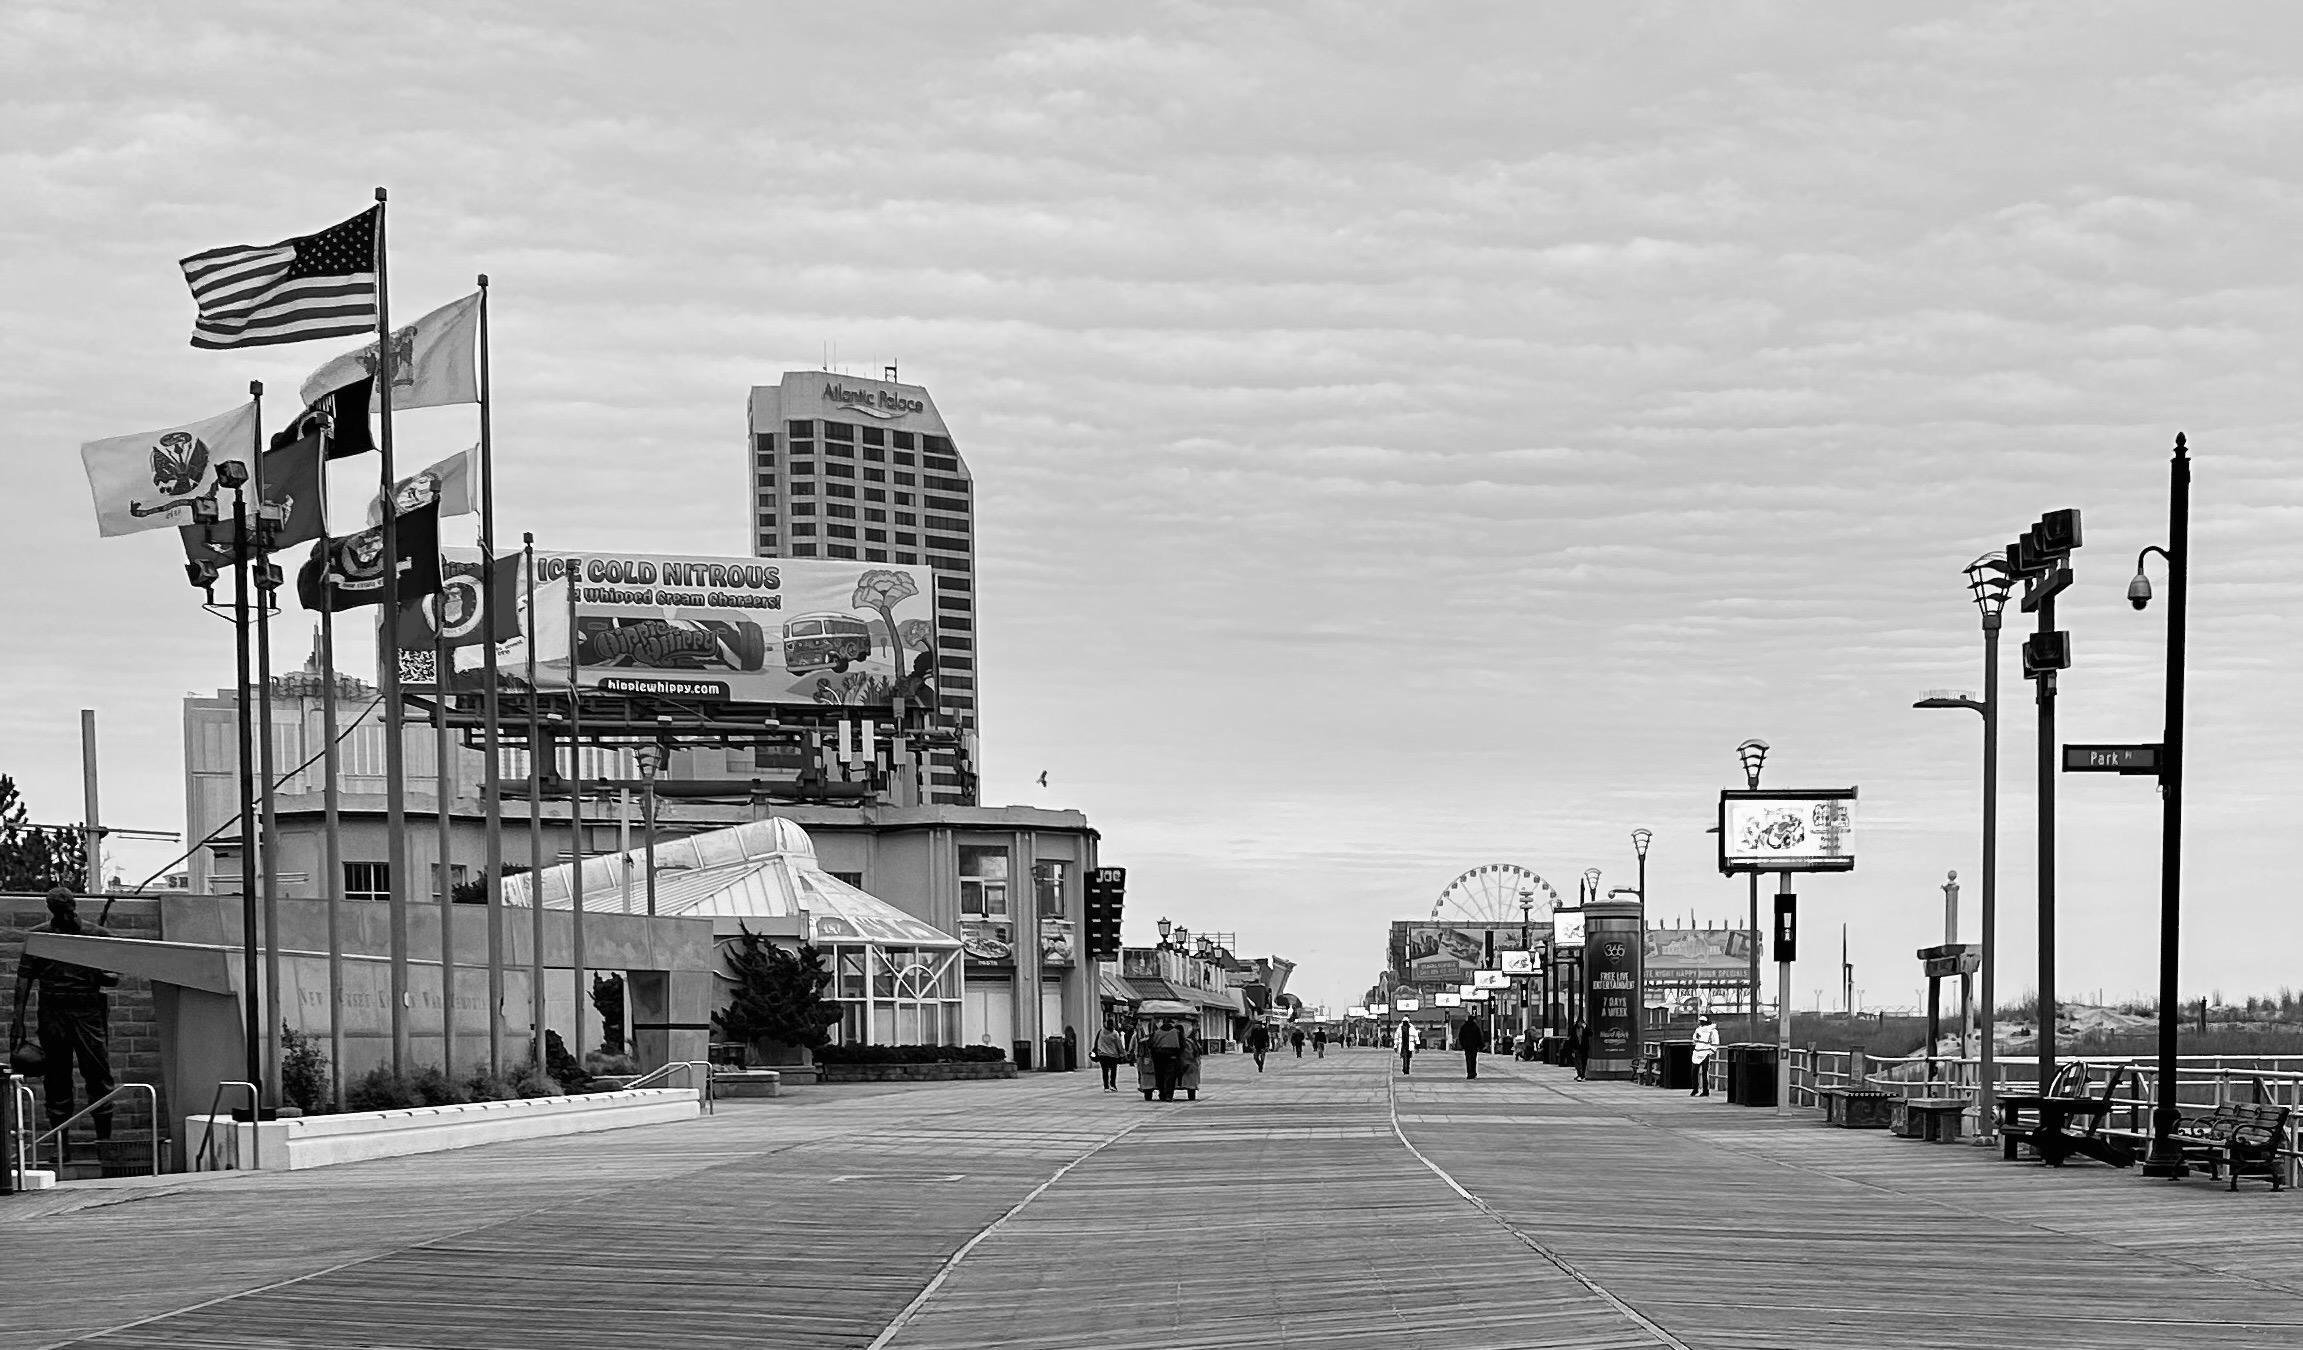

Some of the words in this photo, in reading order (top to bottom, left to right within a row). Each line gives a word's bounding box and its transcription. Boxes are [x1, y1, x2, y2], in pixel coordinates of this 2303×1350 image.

[822, 382, 875, 405] Atlantic
[878, 390, 924, 413] Palace
[537, 557, 583, 583] ICE
[587, 558, 658, 585] COLD
[662, 561, 782, 591] NITROUS
[583, 587, 654, 605] Whipped
[655, 590, 706, 607] Cream
[707, 592, 782, 610] Chargers!
[606, 679, 720, 695] hippiewhippy.com
[2090, 750, 2119, 766] Park
[1603, 943, 1626, 957] 365
[1600, 971, 1615, 981] FREE
[1616, 971, 1629, 981] LIVE
[1592, 980, 1635, 990] ENTERTAINMENT
[1608, 997, 1627, 1007] DAYS
[1600, 1007, 1607, 1017] A
[1607, 1007, 1628, 1017] WEEK
